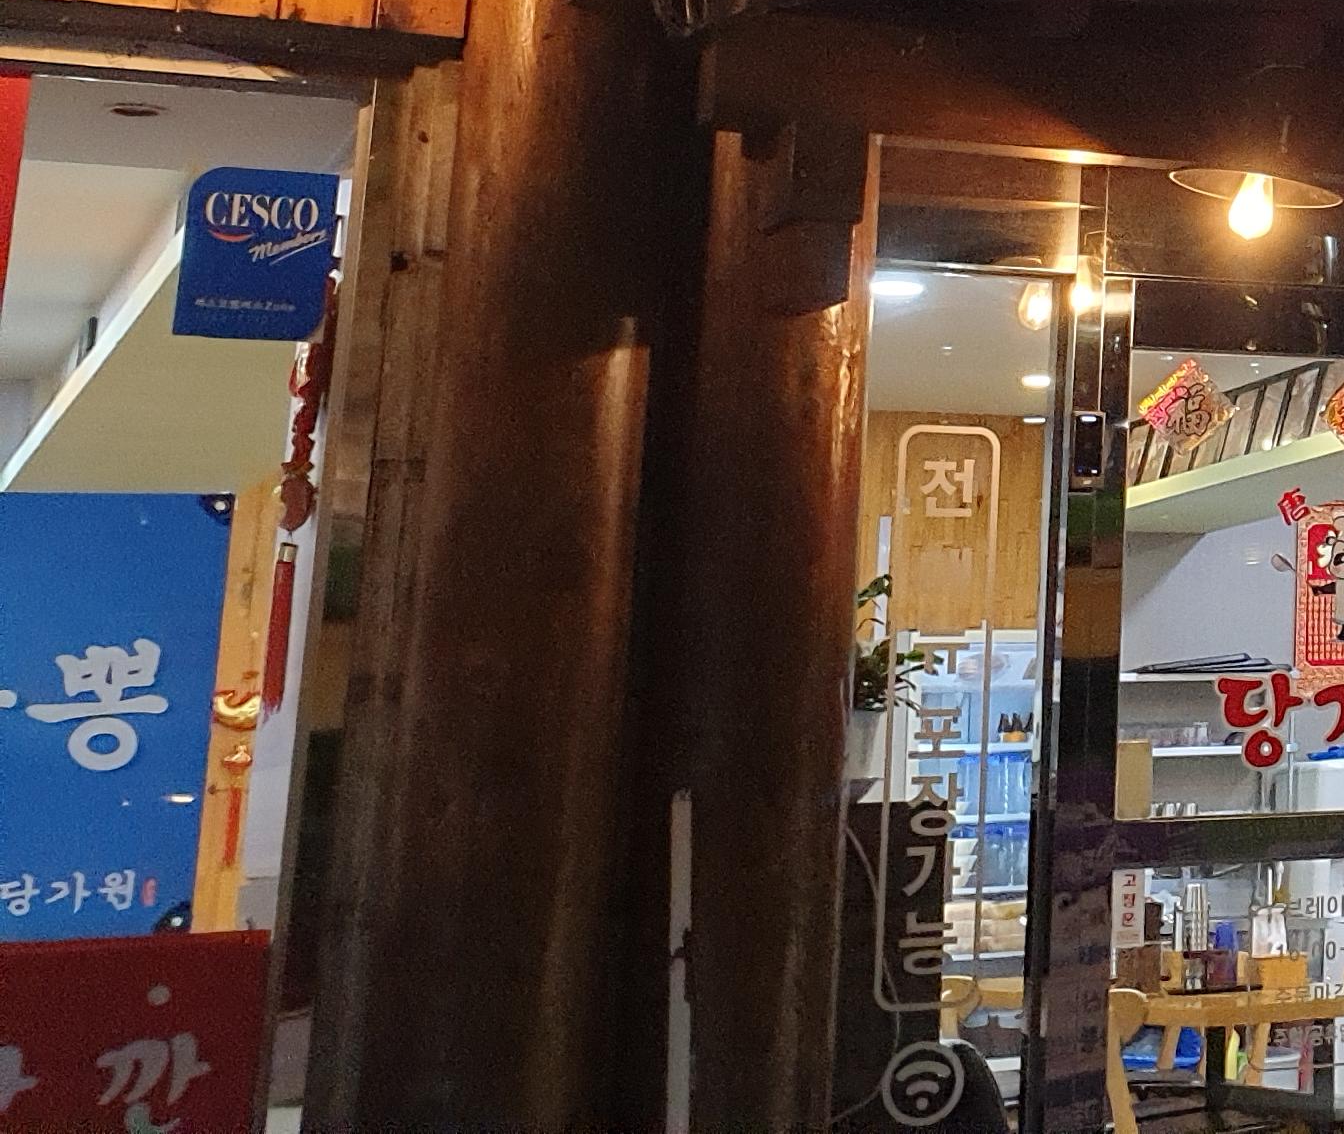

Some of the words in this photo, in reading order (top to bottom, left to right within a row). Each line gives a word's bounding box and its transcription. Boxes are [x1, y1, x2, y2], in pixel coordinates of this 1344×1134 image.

[205, 192, 319, 232] CESCO
[920, 459, 975, 517] 전
[0, 638, 168, 771] 뽕
[899, 707, 965, 975] 포장가능
[0, 870, 136, 917] 당가원
